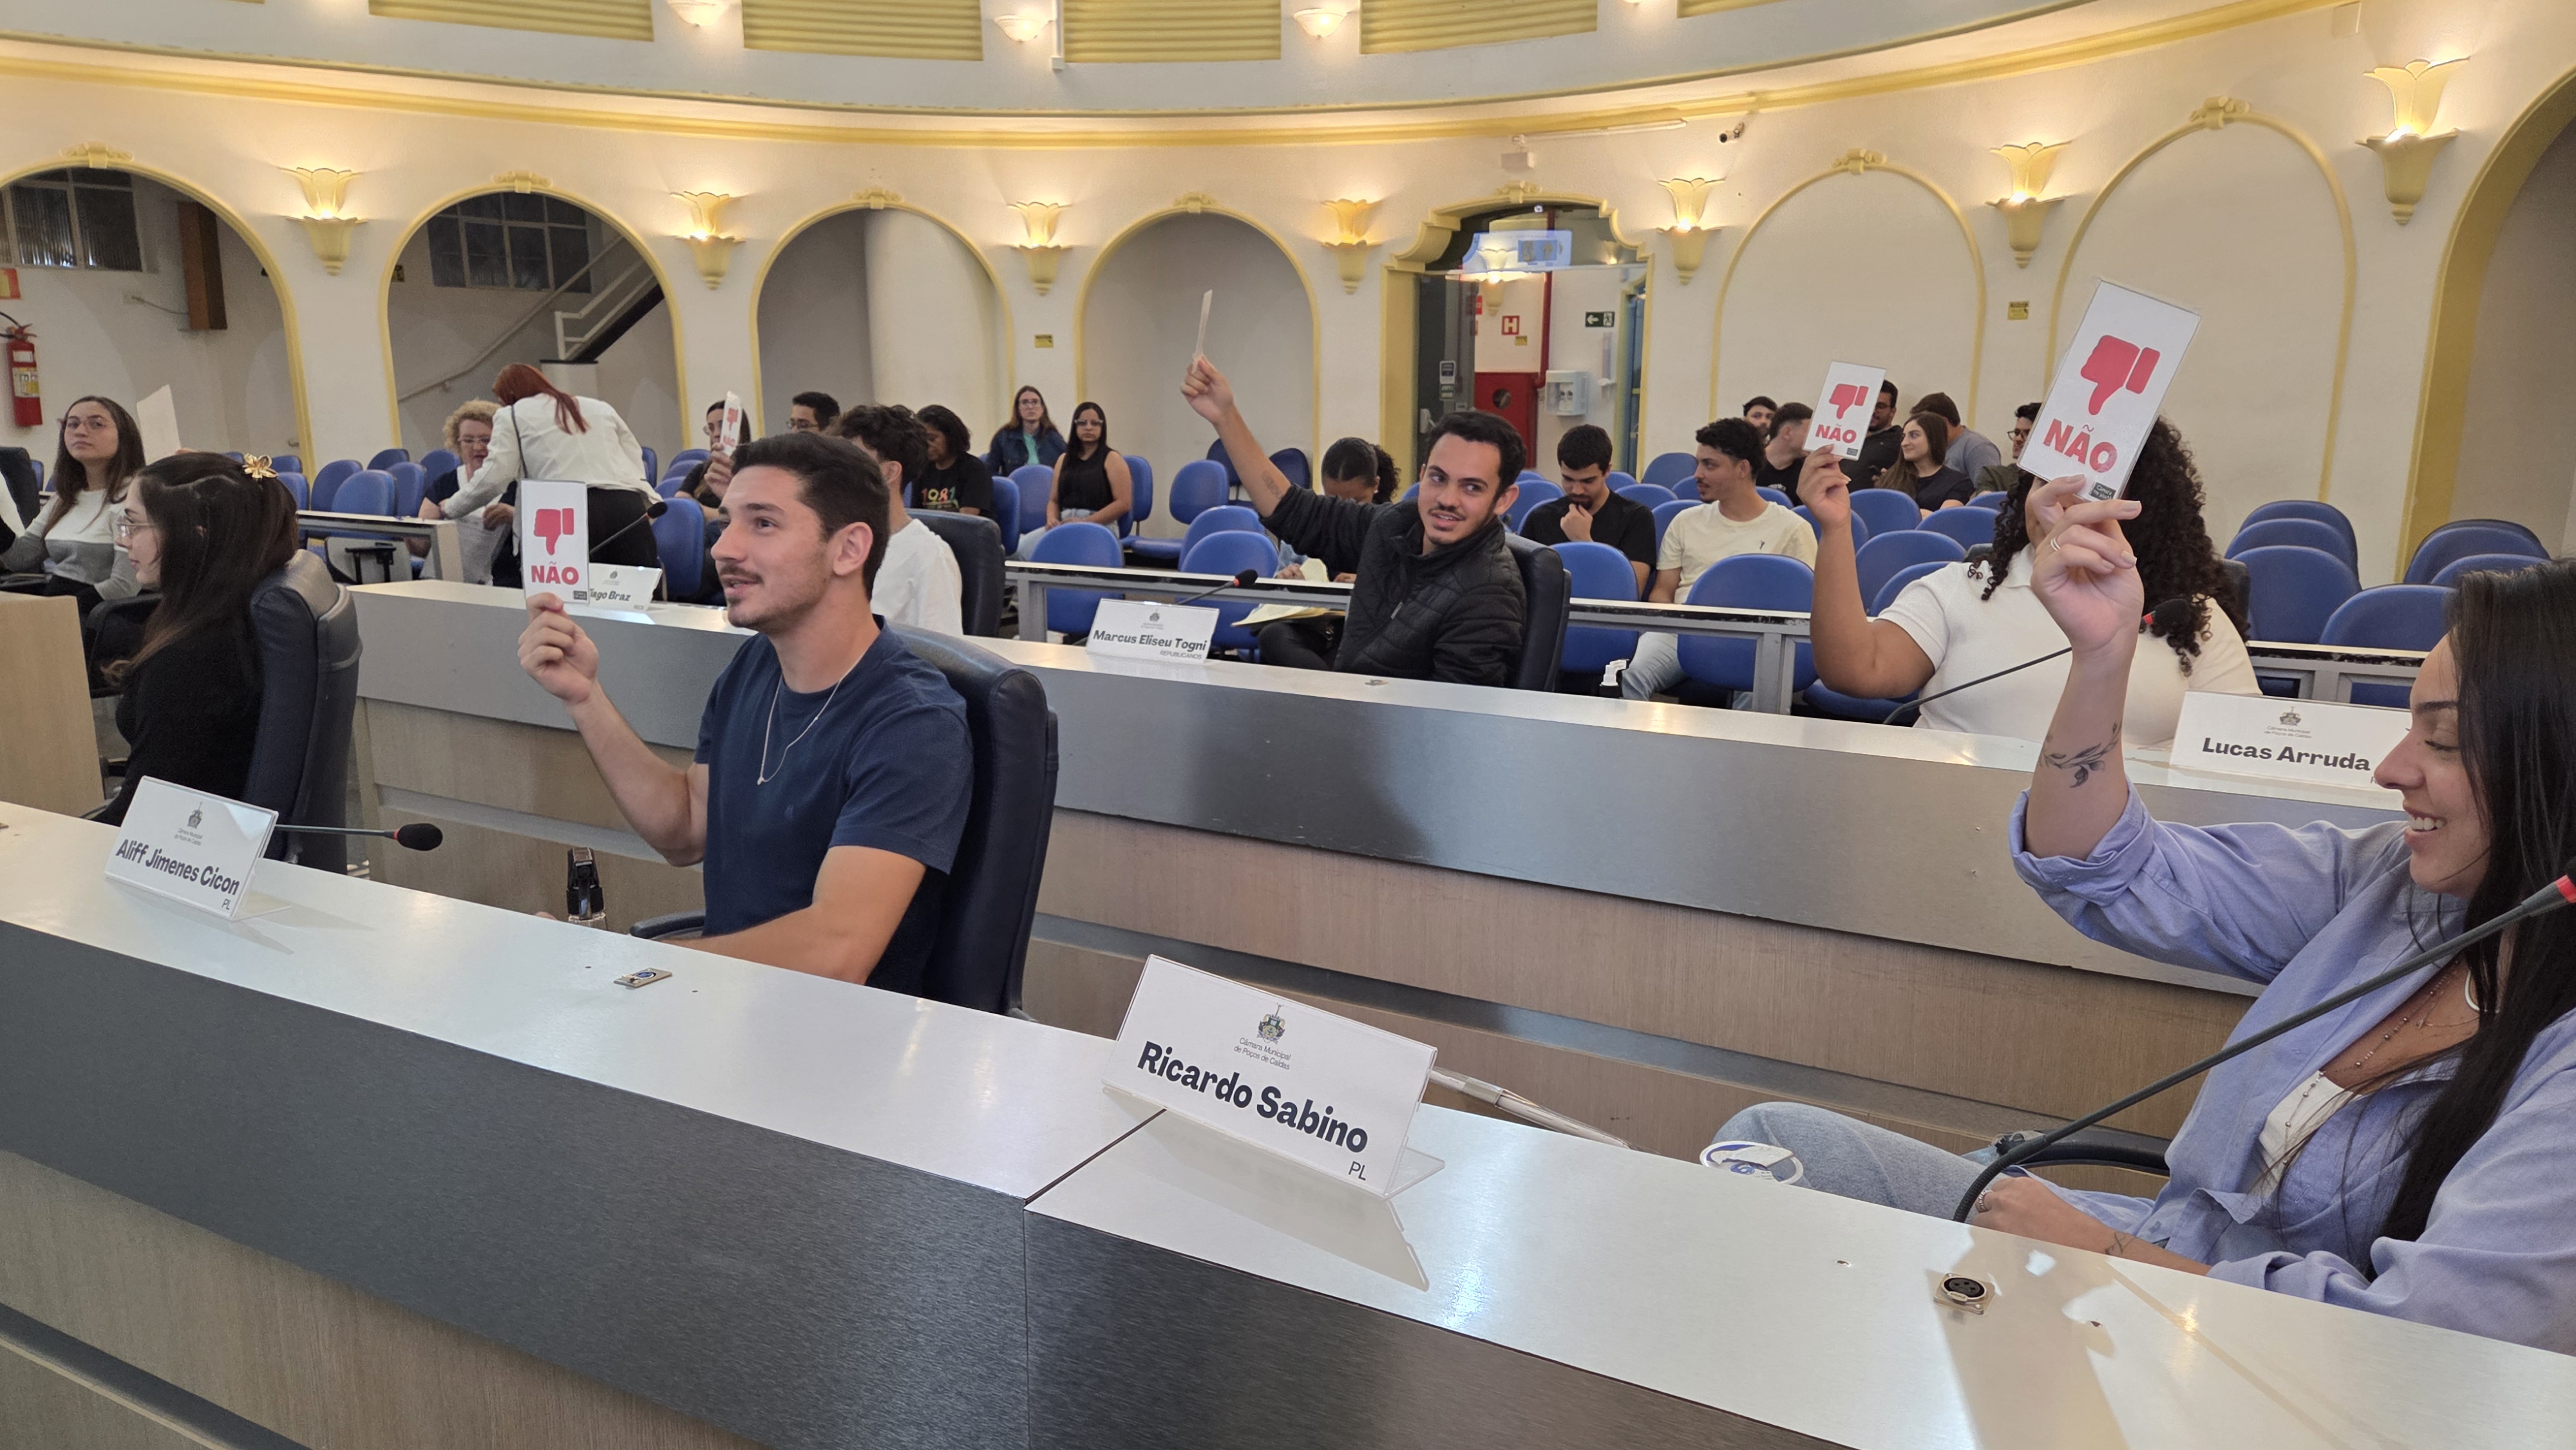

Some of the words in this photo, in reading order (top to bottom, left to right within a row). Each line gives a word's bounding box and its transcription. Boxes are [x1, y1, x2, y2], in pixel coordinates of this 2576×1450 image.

[1815, 423, 1857, 444] NÃO
[2043, 419, 2117, 473] NÃO
[531, 561, 579, 585] NÃO
[609, 590, 631, 601] Braz
[1093, 630, 1137, 645] Marcus
[1139, 634, 1173, 648] Eliseu
[1174, 638, 1208, 652] Togni
[1160, 650, 1202, 660] REPUBLICANOS
[2202, 737, 2272, 759] Lucas
[2276, 746, 2371, 771] Arruda
[115, 839, 149, 863] Aliff
[146, 848, 200, 881] Jimenes
[200, 865, 240, 896] Cicon
[222, 898, 231, 910] PL
[1239, 1037, 1263, 1051] Câmara
[1264, 1046, 1291, 1060] Municipal
[1242, 1048, 1260, 1059] Poços
[1269, 1057, 1290, 1070] Caldas
[1137, 1040, 1253, 1108] Ricardo
[1256, 1086, 1368, 1153] Sabino
[1348, 1161, 1367, 1181] PL
